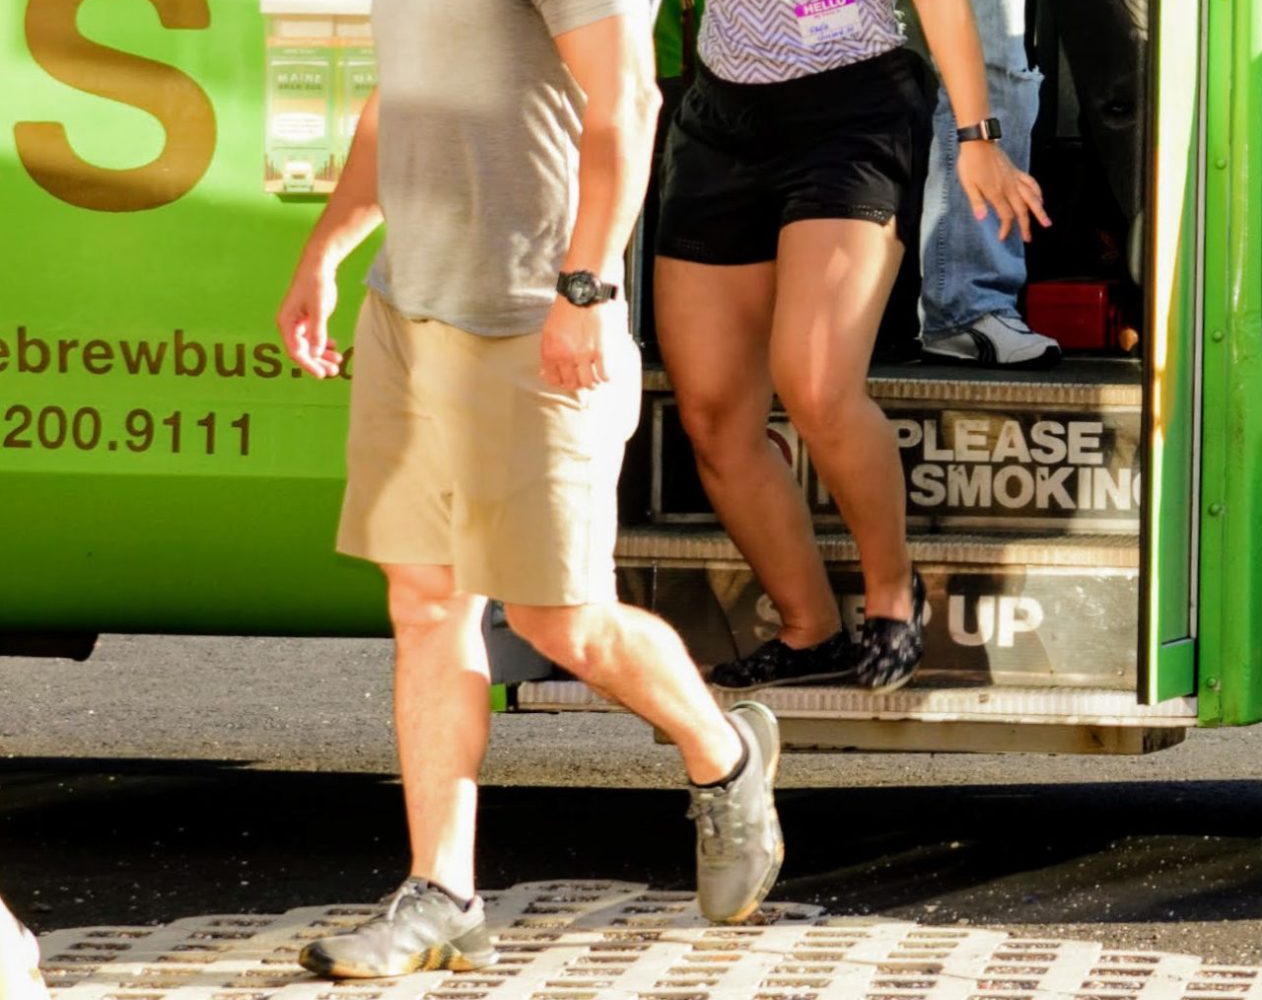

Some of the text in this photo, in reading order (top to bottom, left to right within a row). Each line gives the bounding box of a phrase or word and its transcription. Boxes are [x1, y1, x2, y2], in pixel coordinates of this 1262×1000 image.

[0, 326, 354, 380] brewbus.
[3, 404, 250, 456] 200.9111
[887, 419, 1104, 465] PLEASE
[909, 463, 1141, 511] SMOKIN
[948, 594, 1045, 648] UP
